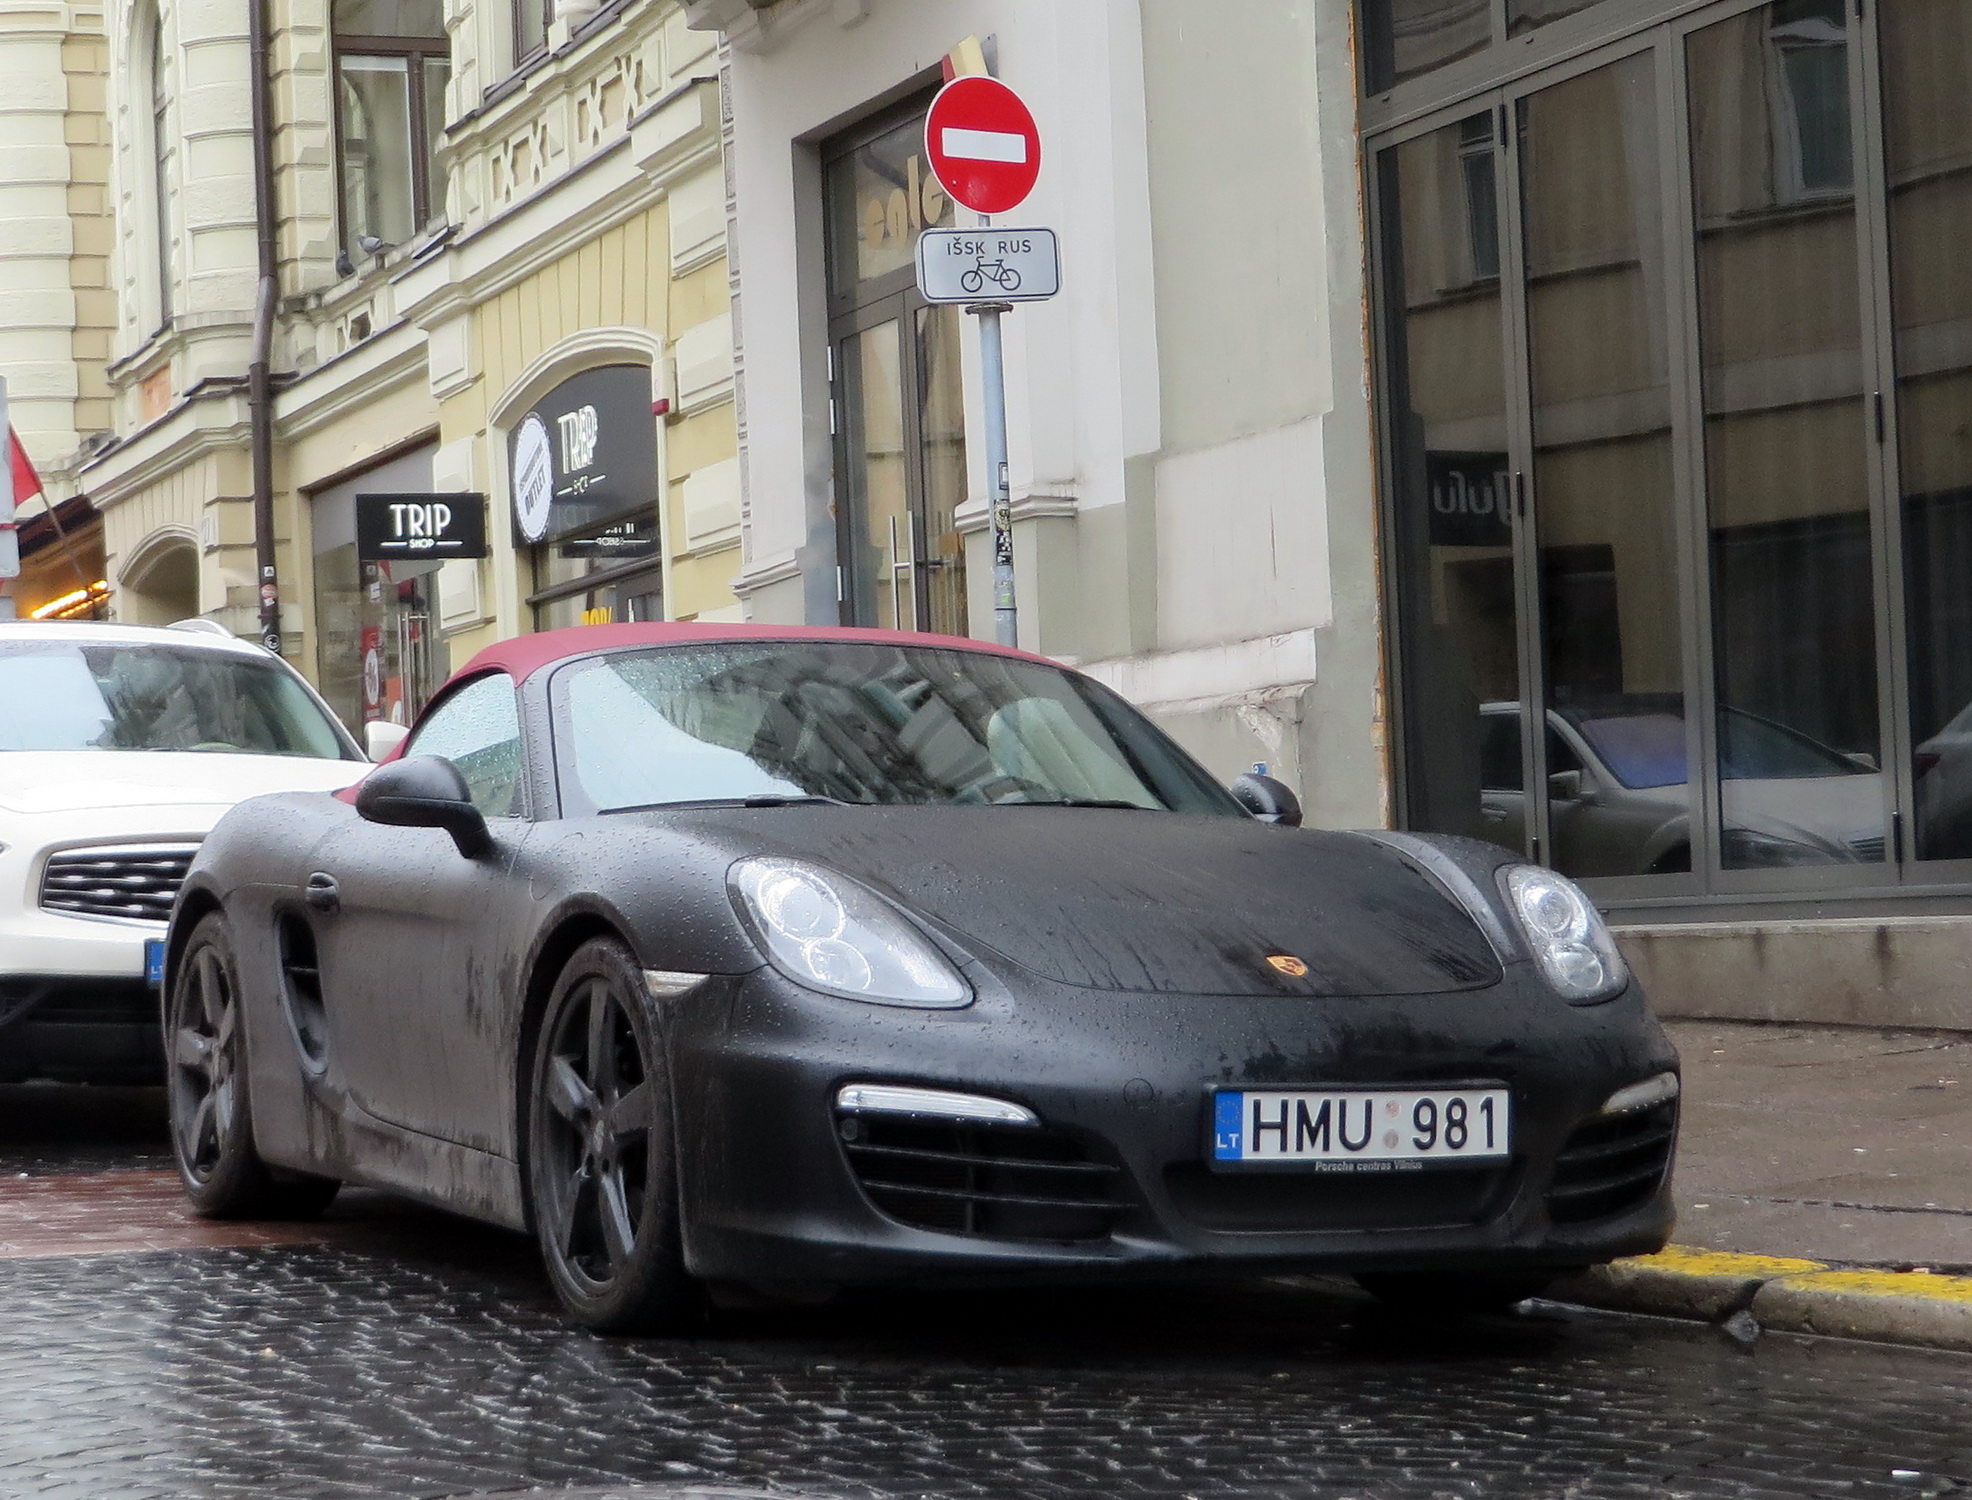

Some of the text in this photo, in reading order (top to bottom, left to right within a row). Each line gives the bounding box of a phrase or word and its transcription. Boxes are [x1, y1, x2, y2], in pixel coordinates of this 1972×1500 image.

[947, 236, 1032, 256] IŠSK RUS
[557, 404, 599, 474] TRIP
[389, 503, 452, 537] TRIP
[409, 538, 435, 549] SHOP
[1216, 1096, 1494, 1152] LT HMU 981
[1315, 1160, 1354, 1171] Porsche
[1393, 1159, 1423, 1170] Vilnius
